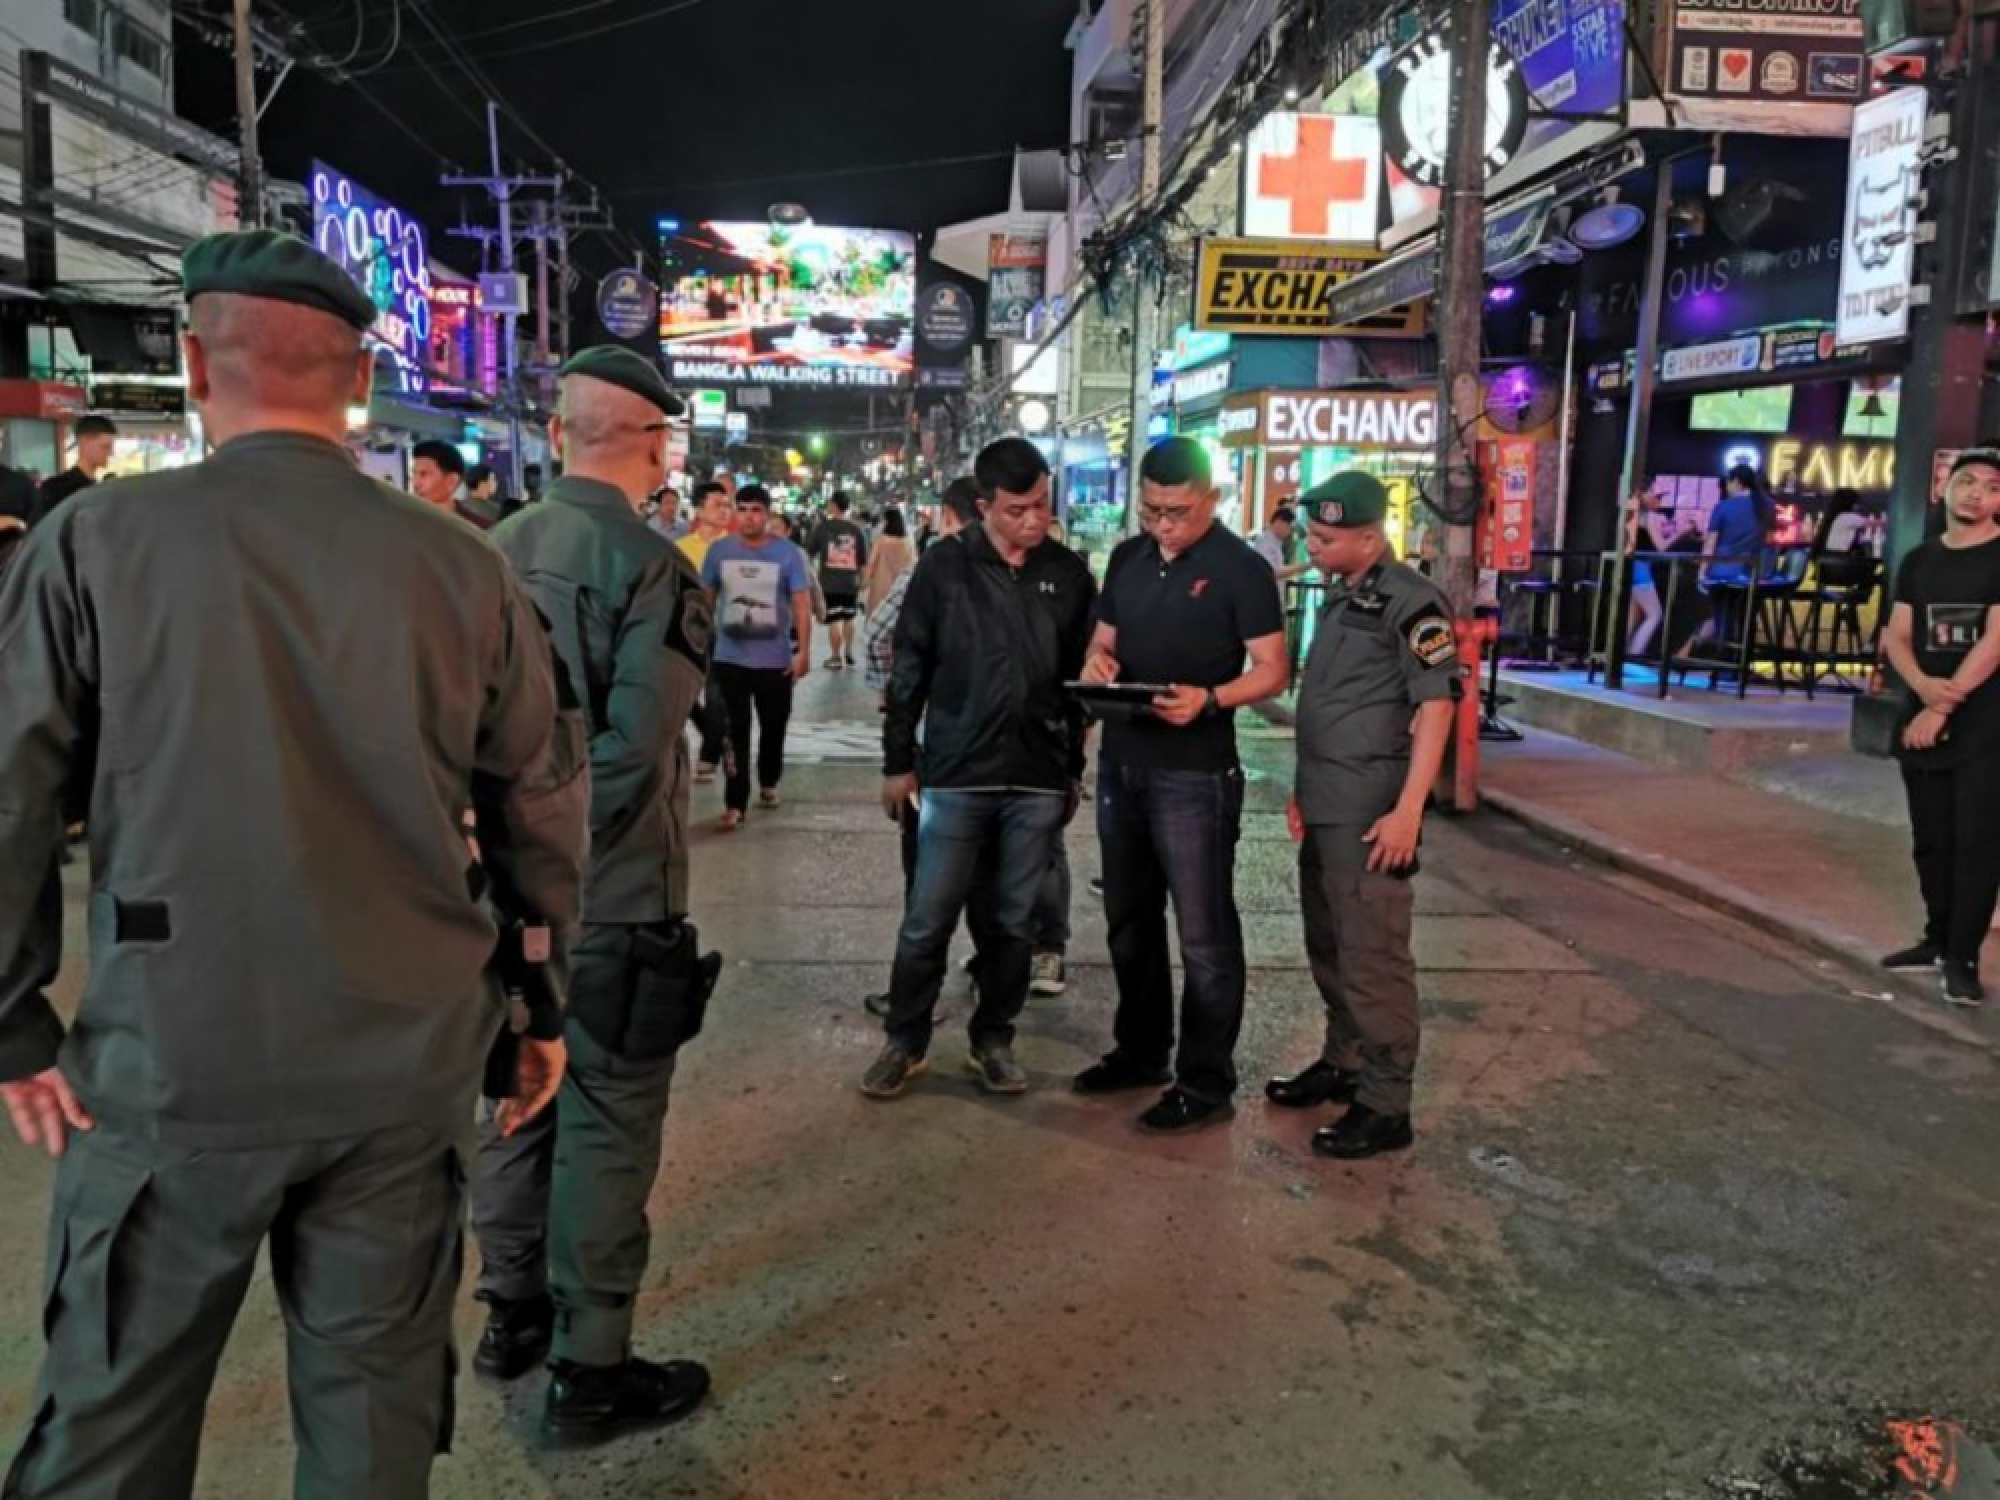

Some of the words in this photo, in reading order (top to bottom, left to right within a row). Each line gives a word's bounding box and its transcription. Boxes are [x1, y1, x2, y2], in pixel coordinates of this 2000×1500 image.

[673, 360, 746, 380] BANGLA
[750, 363, 833, 383] WALKING
[836, 367, 898, 386] STREET
[1266, 395, 1437, 444] EXCHANG
